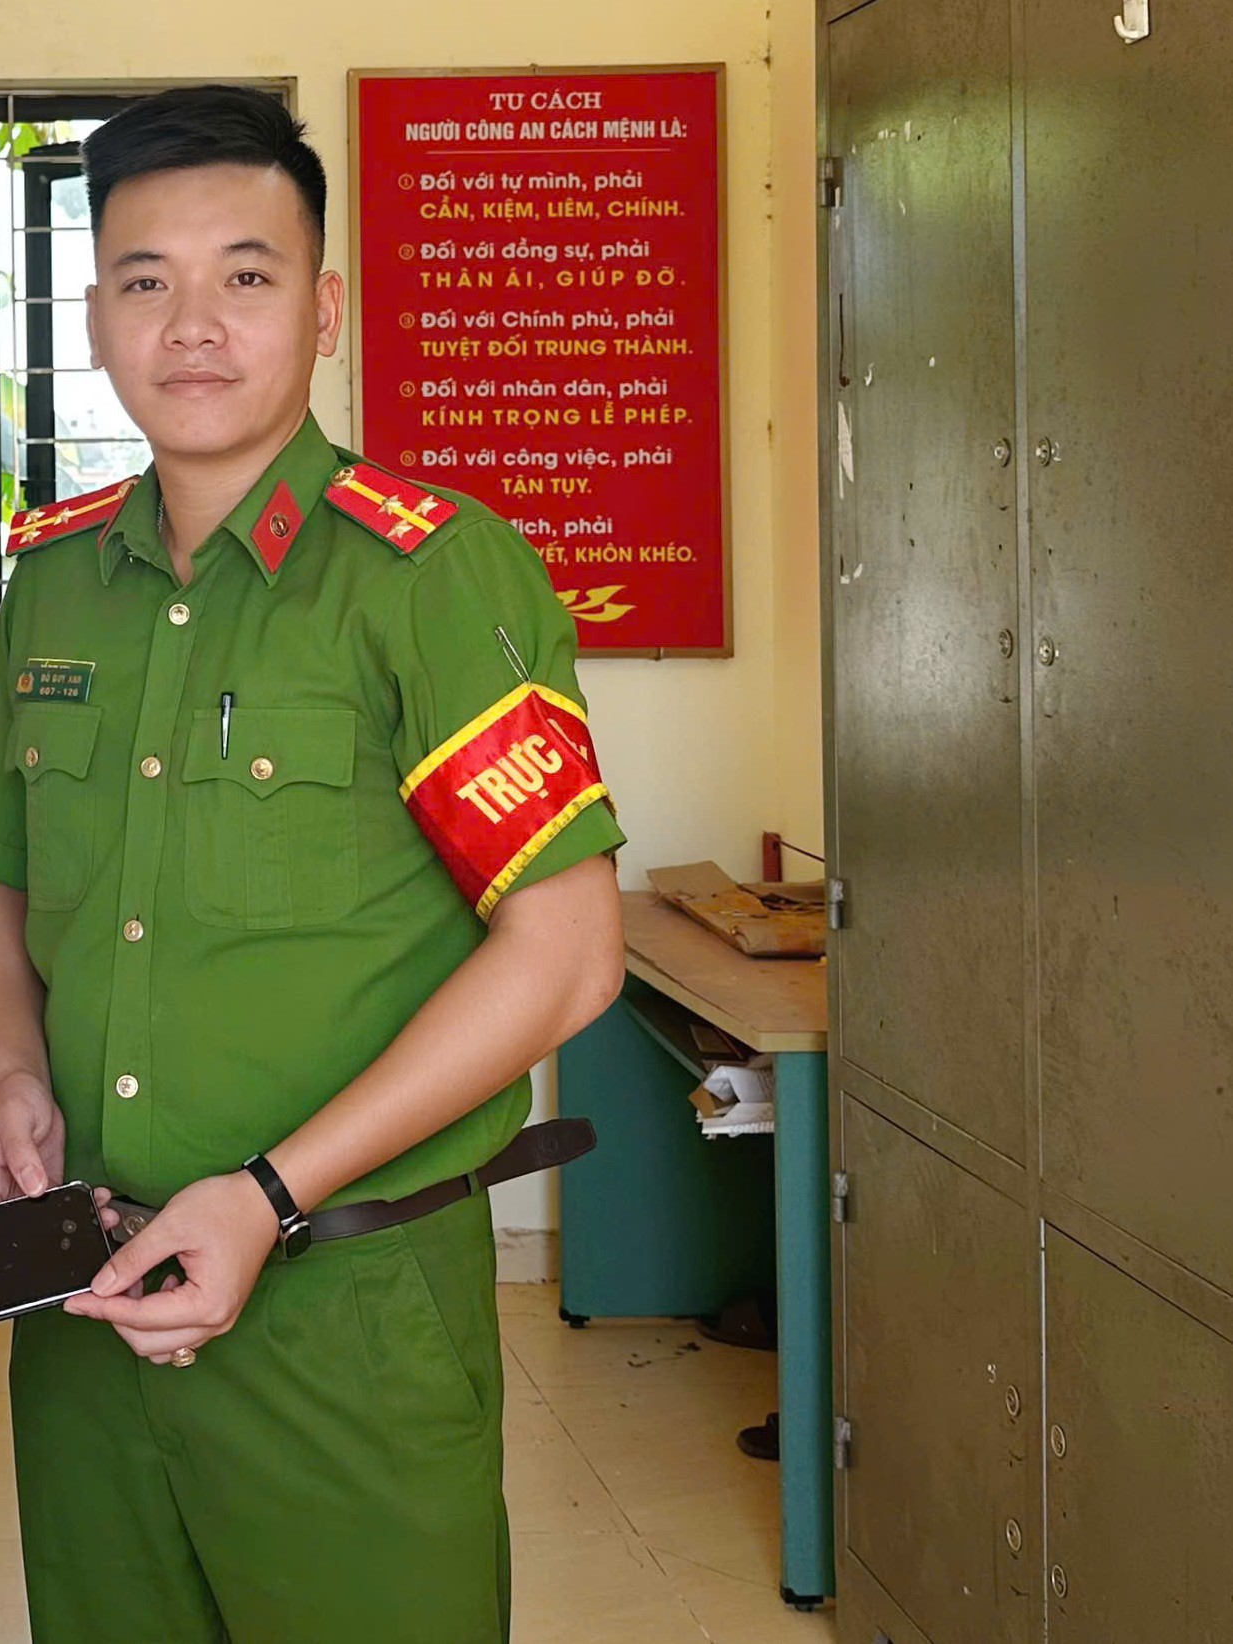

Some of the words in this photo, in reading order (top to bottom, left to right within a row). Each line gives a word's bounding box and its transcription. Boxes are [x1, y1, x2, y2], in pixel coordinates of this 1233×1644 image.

[530, 89, 602, 109] CÁCH
[405, 119, 461, 141] NGƯỜI
[465, 119, 515, 140] CÔNG
[519, 122, 546, 139] AN
[549, 118, 598, 139] CÁCH
[602, 118, 656, 142] MỆNH
[419, 171, 456, 190] Đối
[462, 172, 495, 190] với
[500, 174, 524, 193] tự
[594, 170, 643, 190] phải
[419, 240, 456, 259] Đối
[462, 242, 495, 259] với
[501, 237, 558, 262] đồng
[601, 239, 650, 260] phải
[419, 266, 494, 287] THÂN
[556, 265, 625, 286] GIÚP
[420, 309, 457, 328] Đối
[463, 311, 496, 328] với
[501, 310, 565, 327] Chính
[625, 308, 674, 330] phải
[419, 336, 482, 360] TUYỆT
[486, 334, 528, 356] ĐỐI
[533, 340, 607, 356] TRUNG
[420, 379, 457, 398] Đối
[463, 380, 496, 397] với
[502, 380, 557, 397] nhân
[619, 377, 668, 397] phải
[422, 404, 484, 426] KÍNH
[492, 409, 581, 429] TRỌNG
[590, 401, 615, 424] LỄ
[421, 448, 458, 467] Đối
[464, 449, 497, 466] với
[502, 448, 559, 471] công
[623, 446, 673, 466] phải
[501, 474, 544, 498] TẬN
[564, 516, 613, 537] phải
[575, 542, 633, 563] KHÔN
[455, 734, 563, 825] TRỰC
